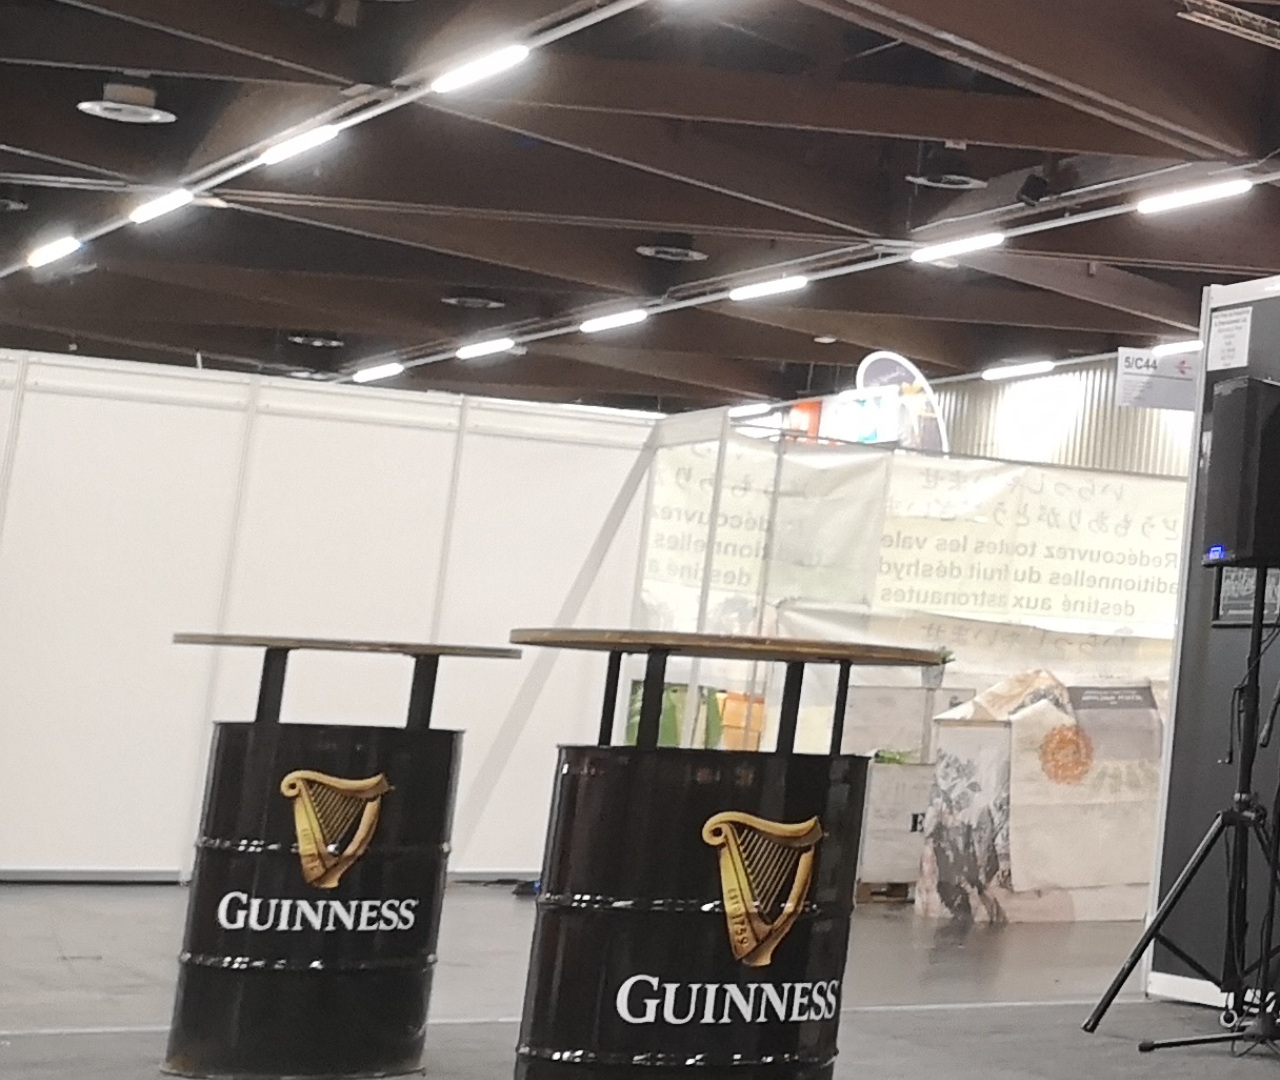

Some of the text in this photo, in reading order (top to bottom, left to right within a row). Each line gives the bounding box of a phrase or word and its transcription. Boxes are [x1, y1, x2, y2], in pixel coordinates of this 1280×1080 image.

[1124, 355, 1158, 370] 5/C44
[217, 891, 419, 932] GUINNESS
[615, 973, 840, 1025] GUINNESS
